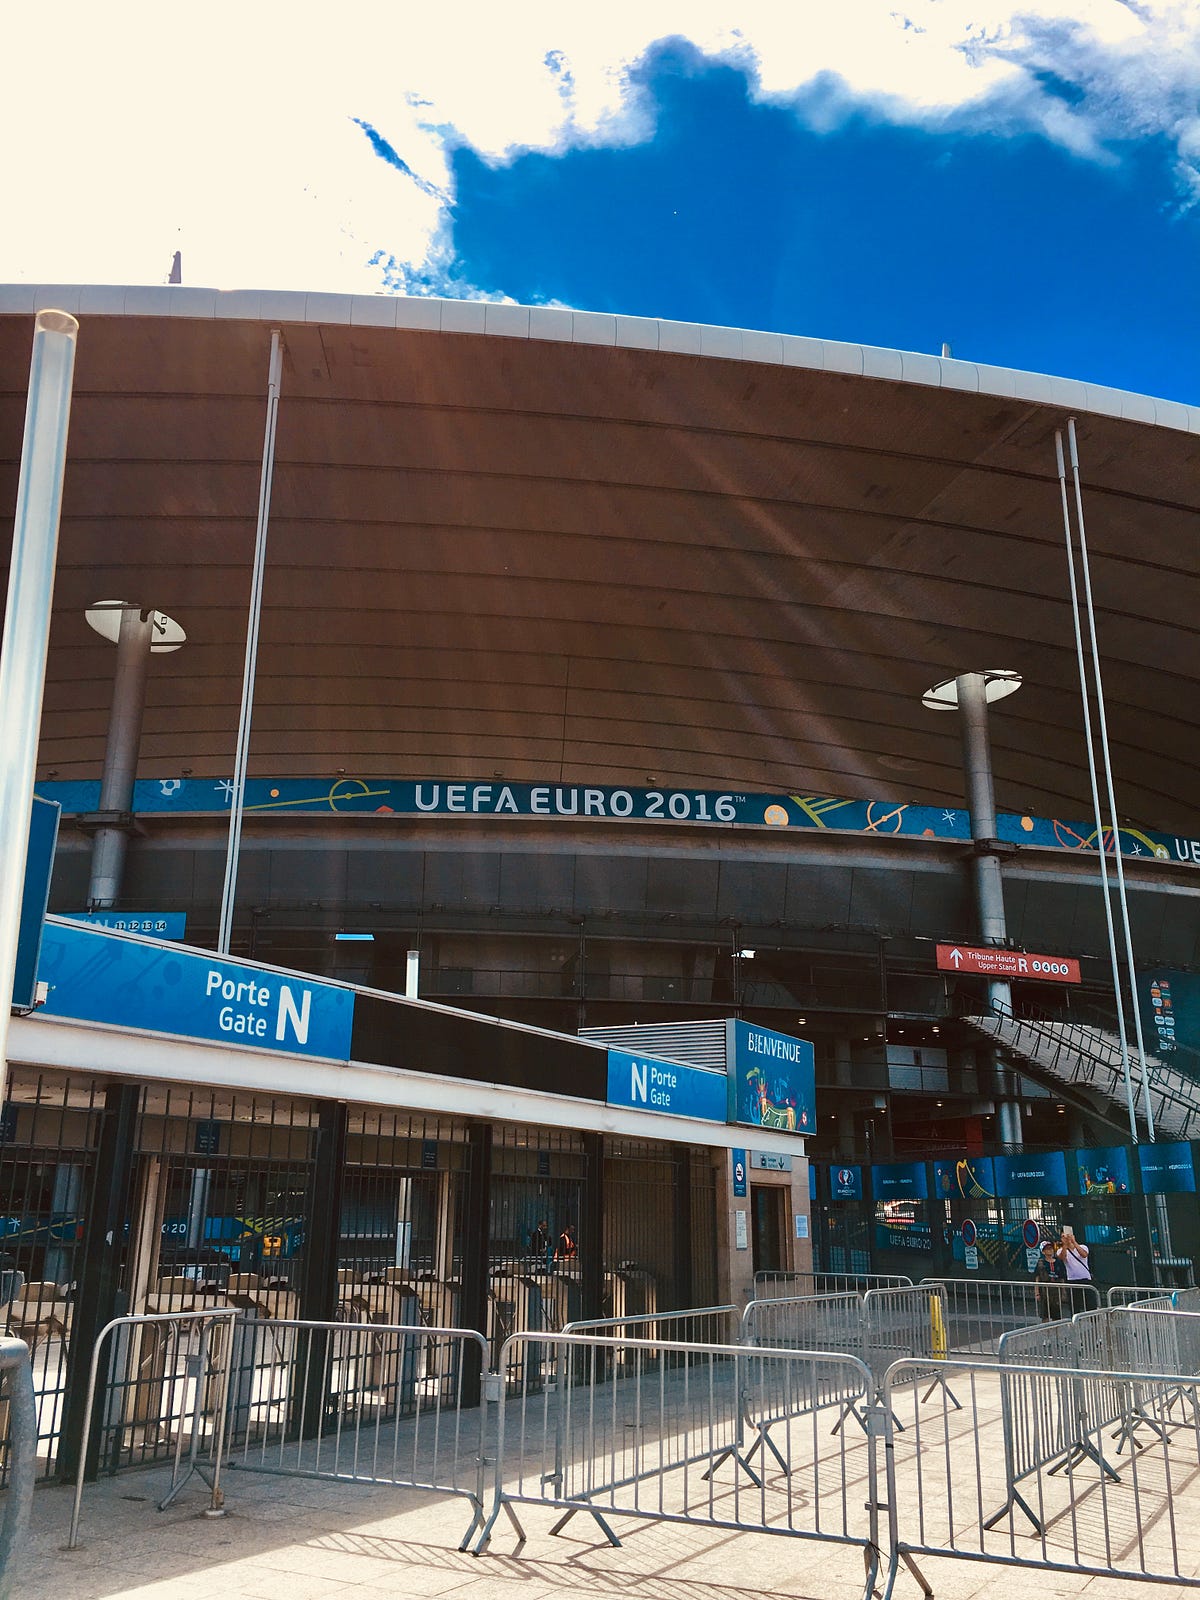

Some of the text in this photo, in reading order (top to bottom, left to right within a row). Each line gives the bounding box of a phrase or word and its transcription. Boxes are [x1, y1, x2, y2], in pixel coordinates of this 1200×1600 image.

[415, 784, 519, 813] UEFA
[530, 787, 634, 817] EURO
[128, 921, 139, 930] 12
[141, 921, 152, 930] 13
[155, 921, 166, 931] 14
[967, 951, 1016, 964] Tribune Haute
[978, 961, 1017, 972] Upper Stand
[1018, 957, 1029, 973] R
[206, 970, 270, 1007] Porte
[219, 1006, 267, 1037] Gate
[275, 985, 312, 1045] N
[748, 1032, 801, 1063] BIENVENUE
[631, 1062, 647, 1103] N
[651, 1067, 677, 1088] Porte
[650, 1089, 671, 1107] Gate
[890, 1234, 906, 1247] UEFA
